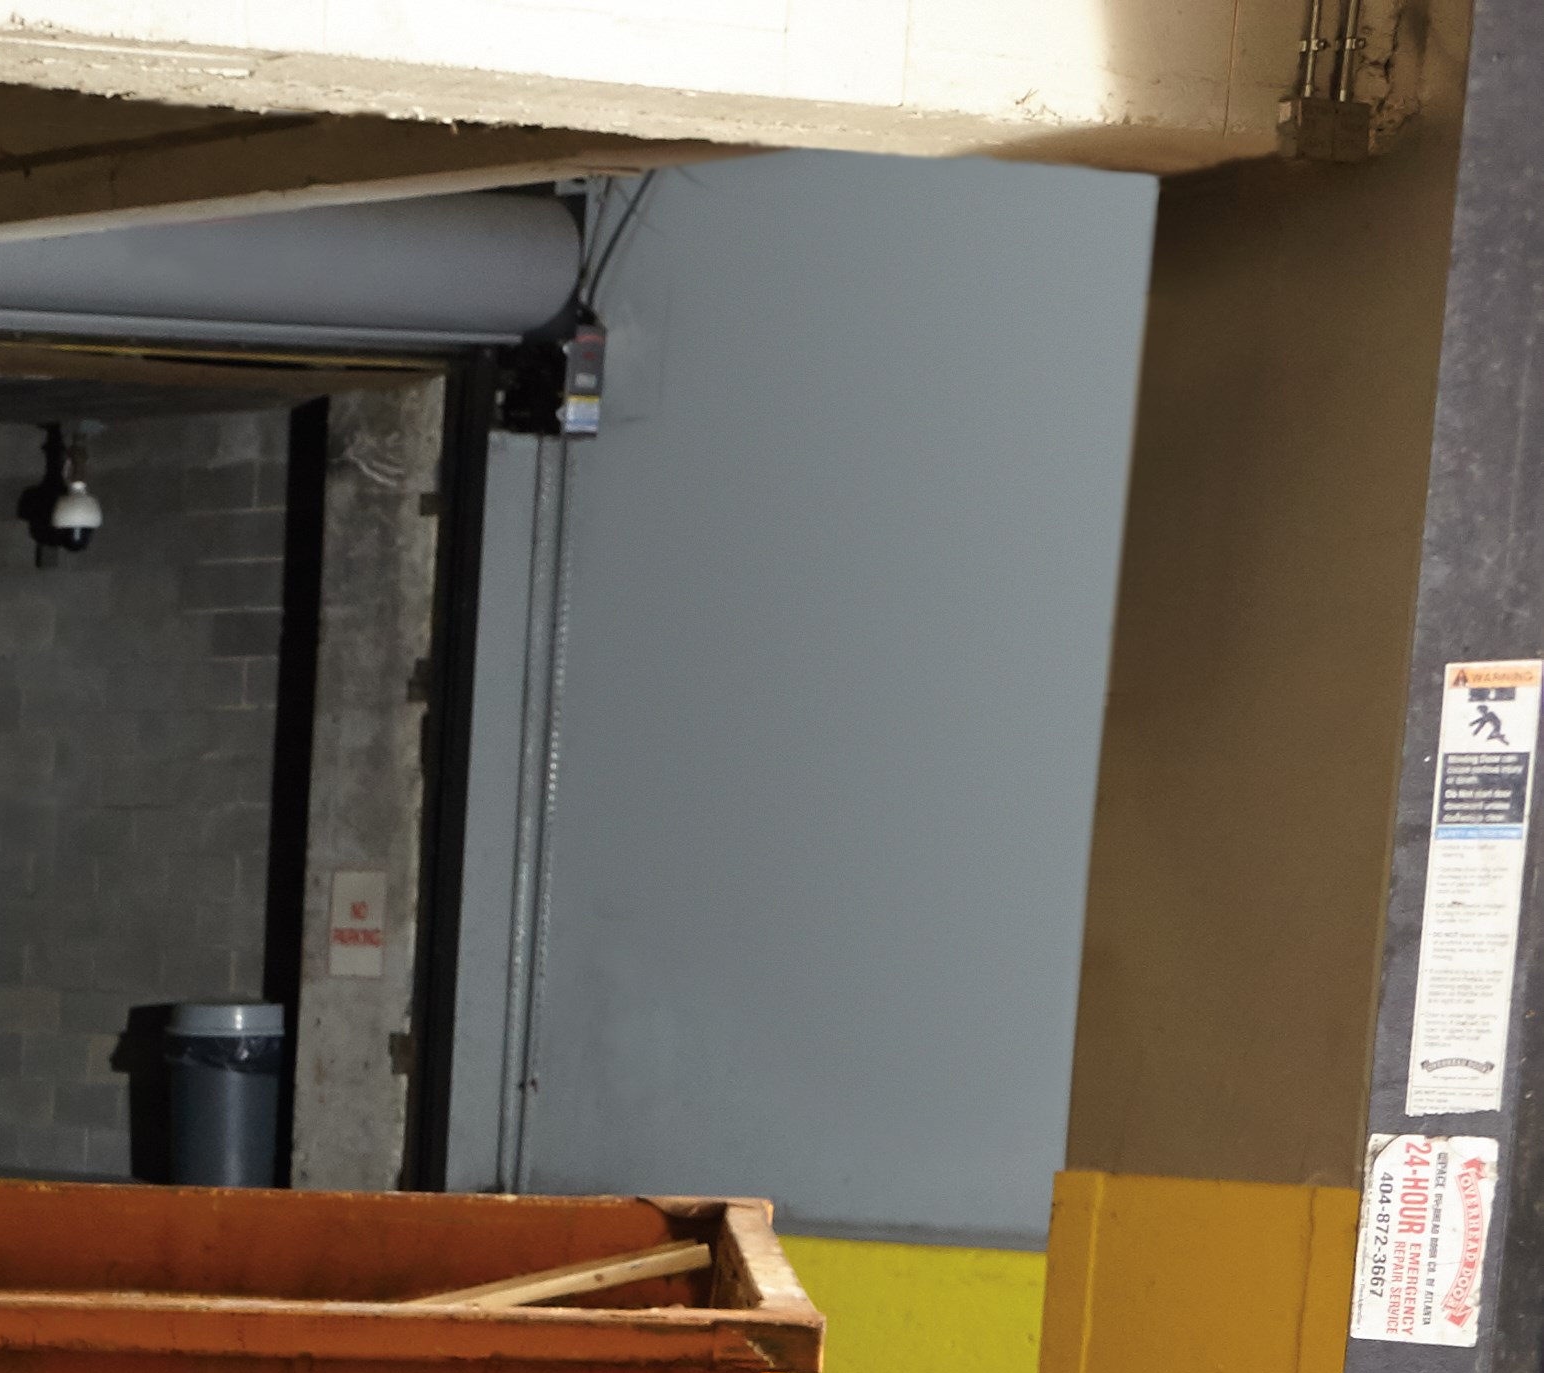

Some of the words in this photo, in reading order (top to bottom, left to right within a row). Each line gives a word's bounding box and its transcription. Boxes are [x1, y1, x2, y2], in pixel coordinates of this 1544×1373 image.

[1471, 670, 1534, 683] WARNING
[1397, 1142, 1432, 1235] 24-HOUR
[1460, 1174, 1481, 1262] OVERHEAD
[1369, 1172, 1394, 1298] 404-872-3667
[1391, 1241, 1406, 1283] REPAIR
[1386, 1287, 1402, 1335] SERVICE
[1401, 1242, 1422, 1336] EMERGENCY
[1421, 1290, 1434, 1326] ATLANTA
